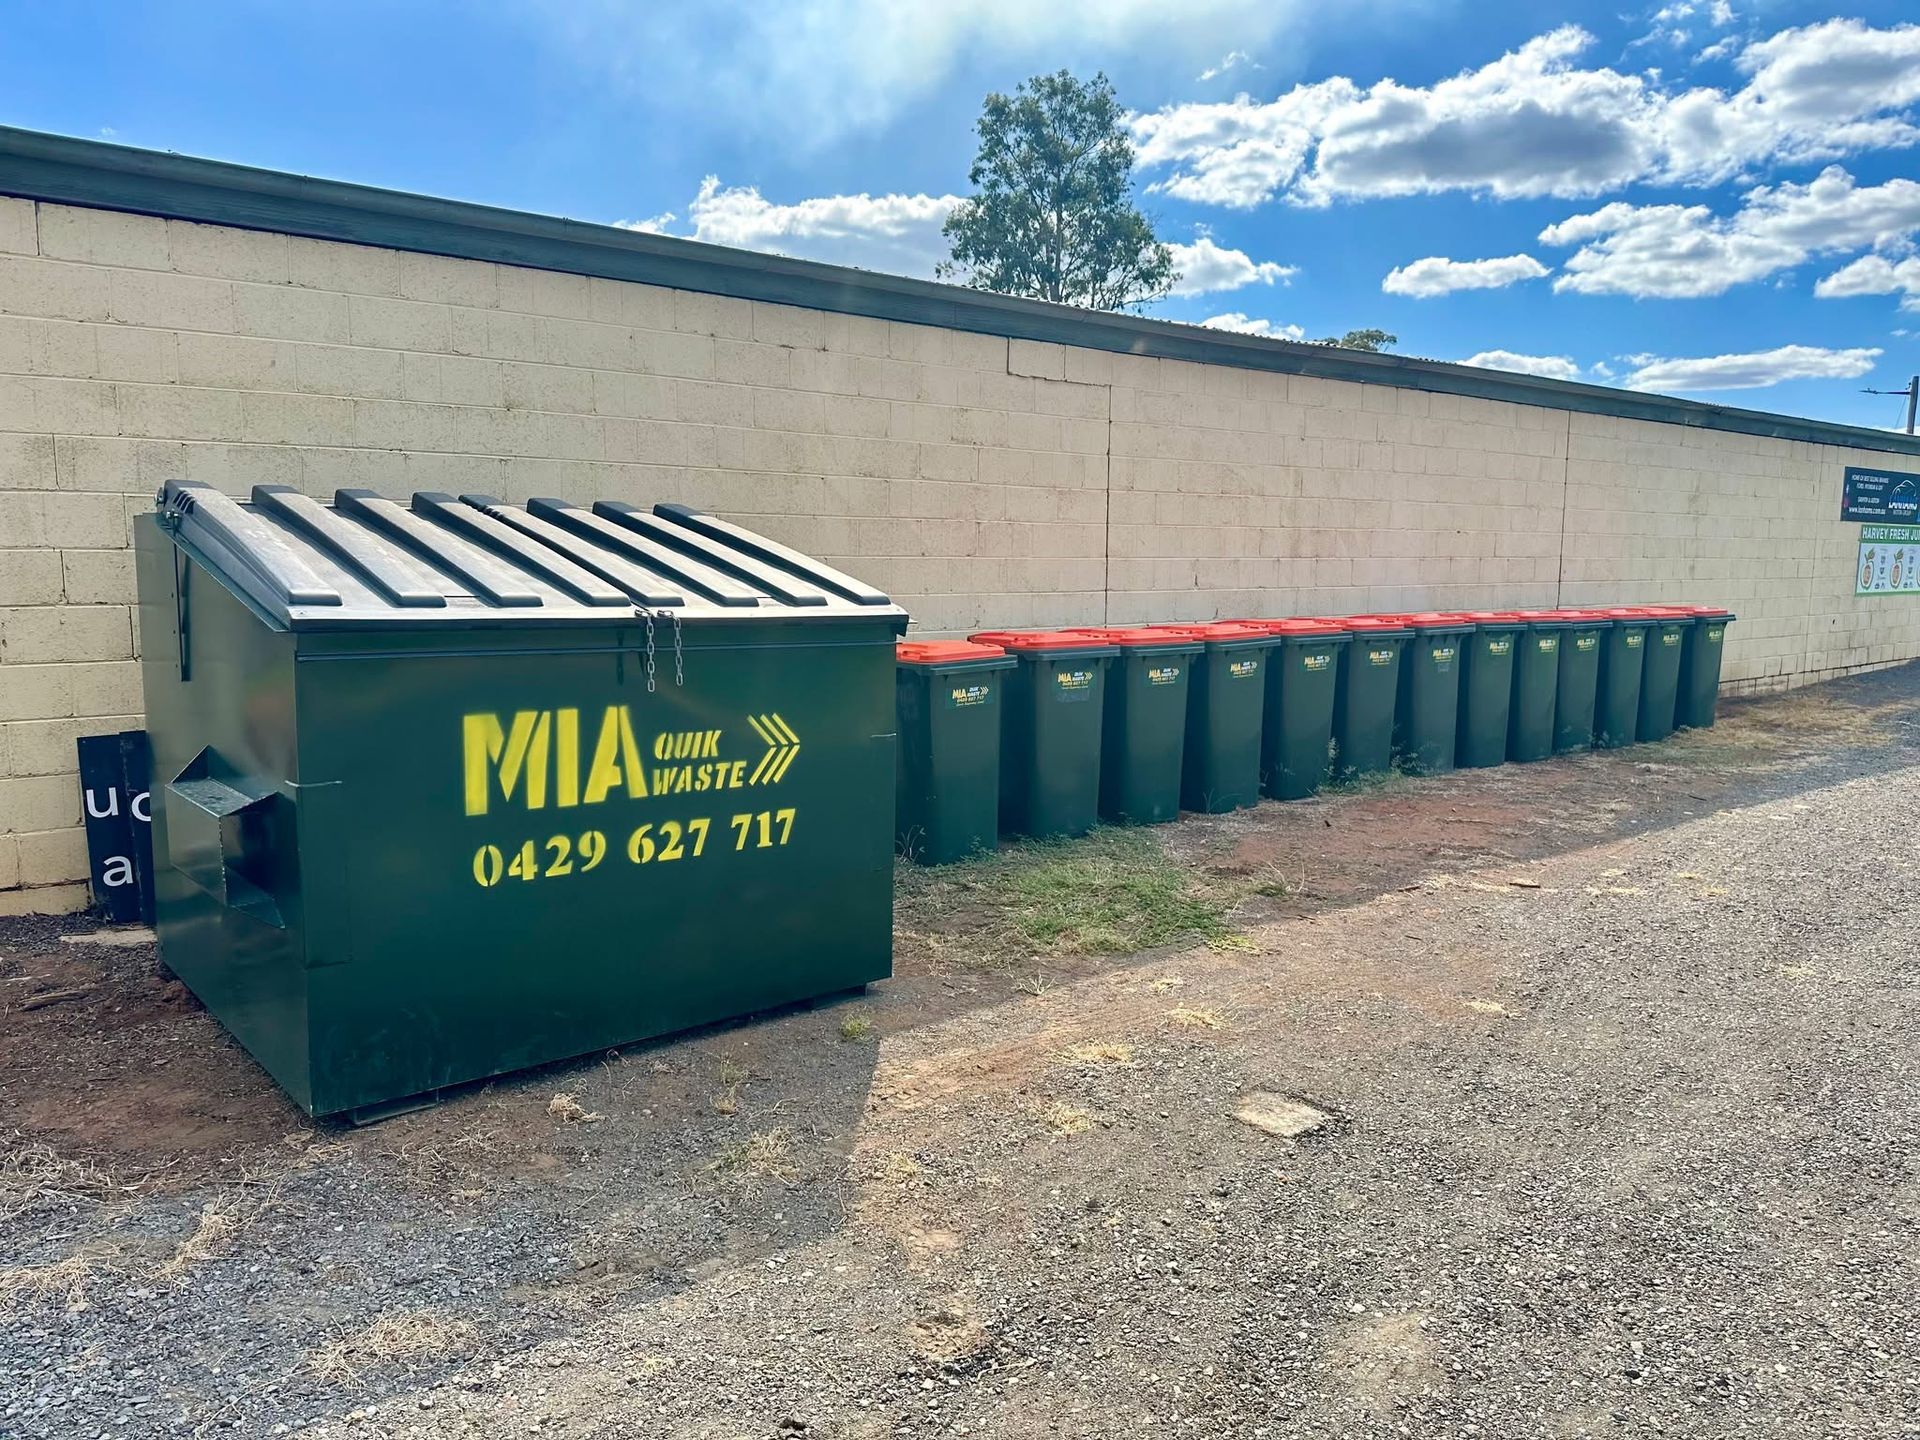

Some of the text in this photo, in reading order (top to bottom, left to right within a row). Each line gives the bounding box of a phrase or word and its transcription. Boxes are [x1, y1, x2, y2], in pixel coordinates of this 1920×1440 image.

[1862, 527, 1888, 540] HARVEY
[1889, 528, 1910, 540] FRESH
[1057, 672, 1072, 683] MIA
[1148, 668, 1161, 678] MIA
[952, 687, 967, 699] MIA
[654, 730, 722, 760] QUIK
[463, 704, 648, 817] MIA
[652, 761, 748, 797] WASTE
[472, 798, 797, 887] 0429 627 717
[102, 855, 134, 888] a
